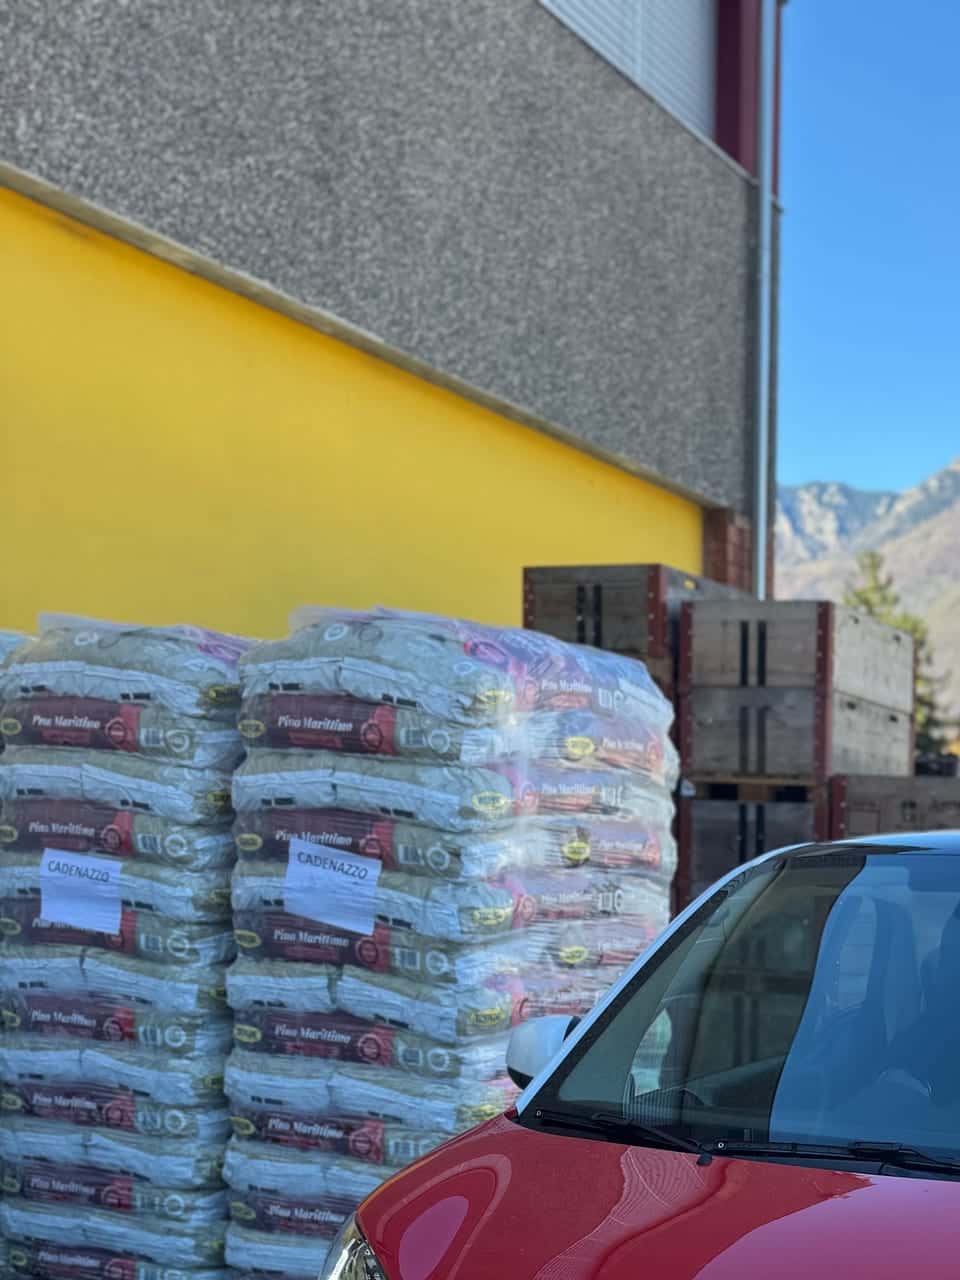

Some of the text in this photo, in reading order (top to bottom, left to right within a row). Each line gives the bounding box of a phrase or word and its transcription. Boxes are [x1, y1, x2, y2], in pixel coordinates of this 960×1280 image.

[278, 715, 352, 732] Pino Marittimo
[48, 860, 111, 883] CADENAZZO
[297, 851, 369, 880] CADENAZZO
[273, 929, 350, 947] Pino Marittimo
[274, 1024, 351, 1044] Pino Marittimo
